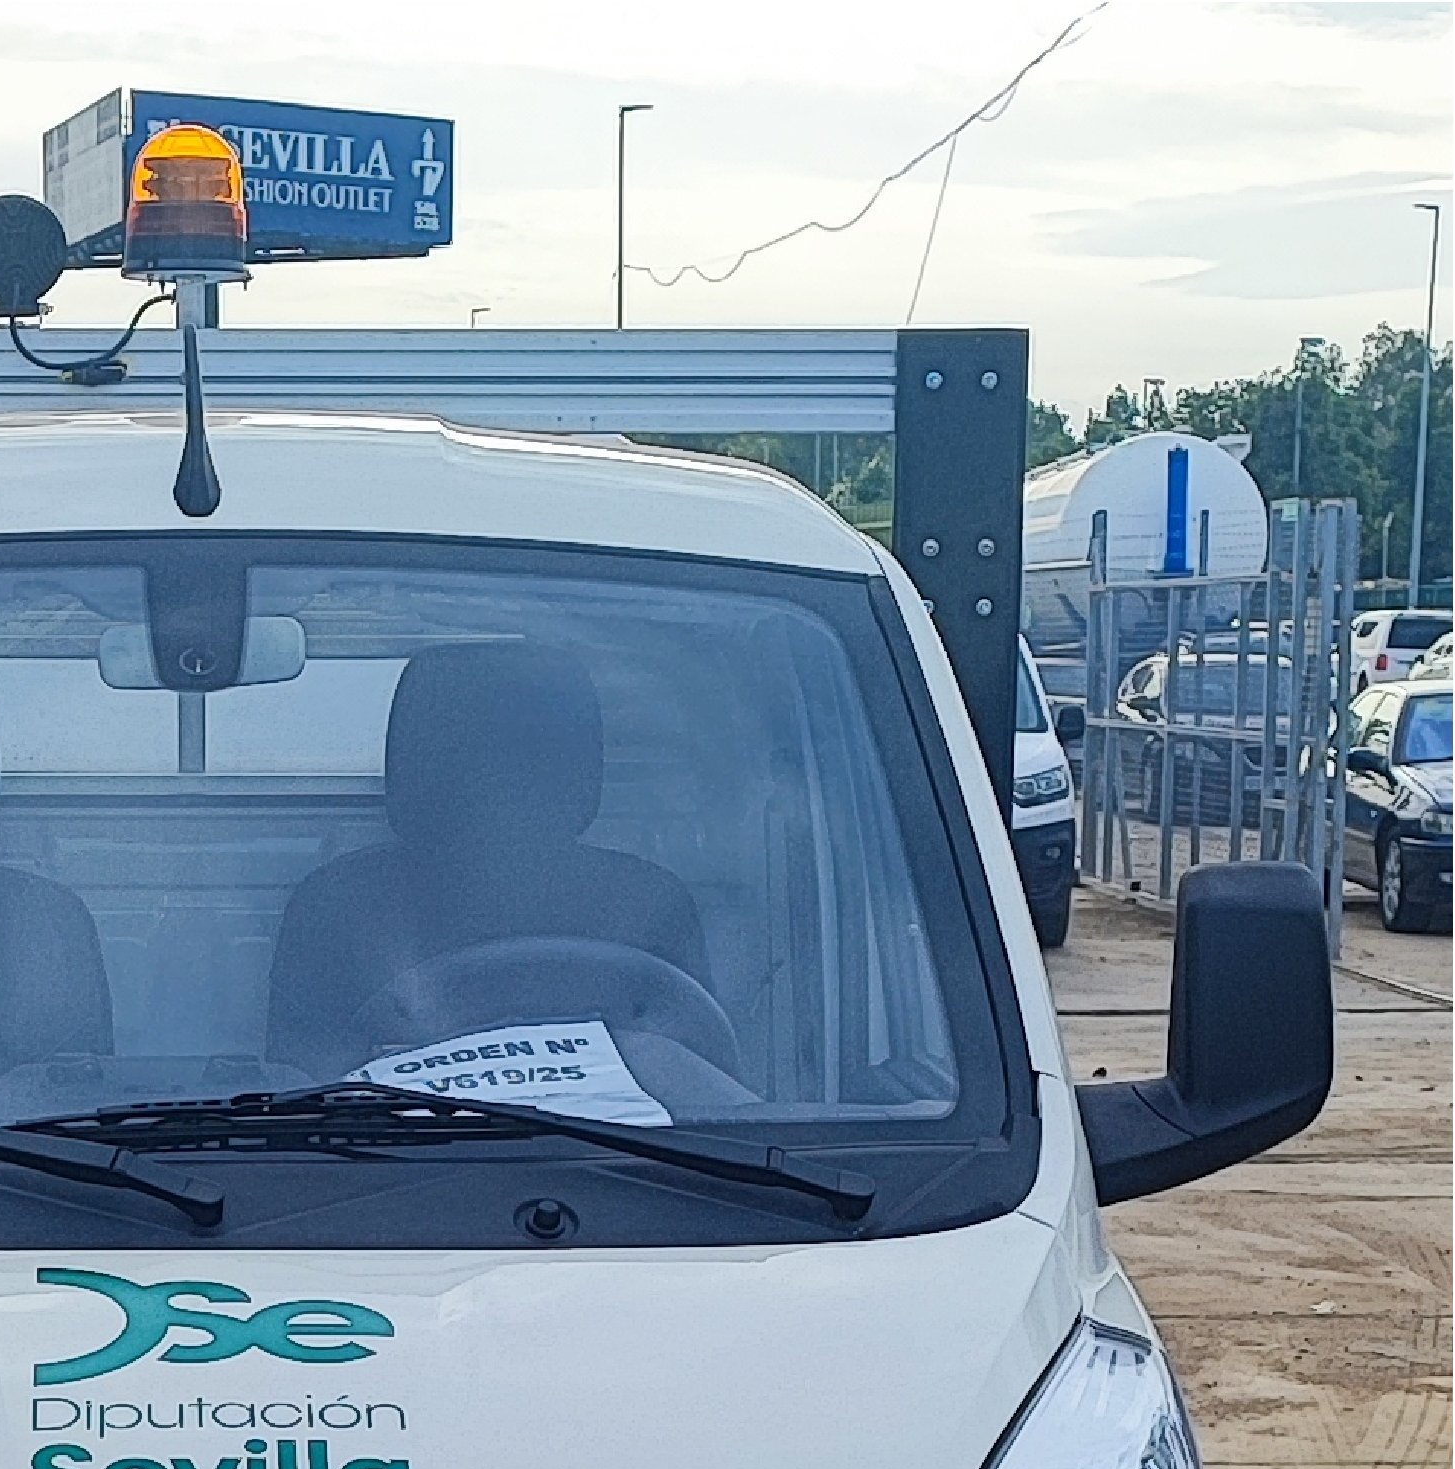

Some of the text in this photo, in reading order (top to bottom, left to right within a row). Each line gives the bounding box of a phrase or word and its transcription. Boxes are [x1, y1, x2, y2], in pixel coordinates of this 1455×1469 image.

[311, 182, 393, 213] OUTLET
[393, 1040, 534, 1074] ORDEN
[32, 1395, 406, 1439] Diputación
